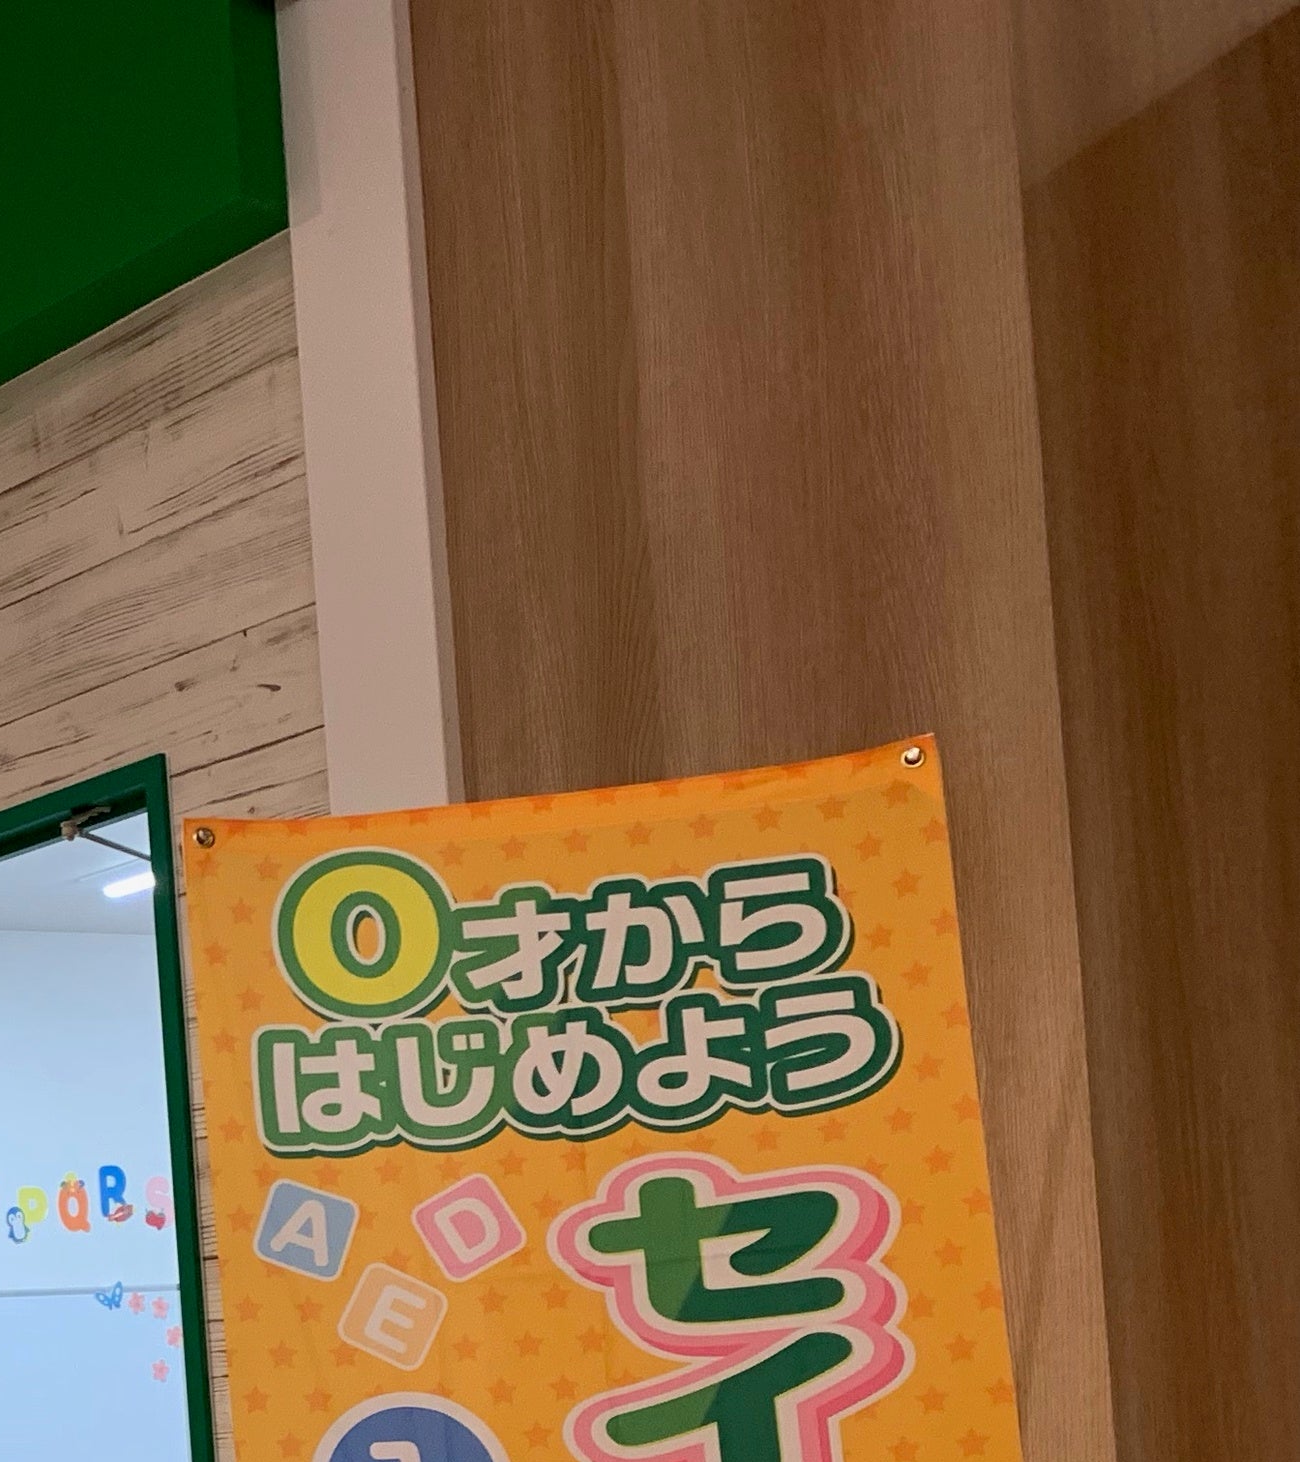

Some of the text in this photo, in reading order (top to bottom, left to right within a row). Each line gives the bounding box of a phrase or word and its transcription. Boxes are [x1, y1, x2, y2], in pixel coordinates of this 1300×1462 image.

[257, 977, 898, 1150] はじめよう
[269, 1197, 335, 1267] A
[430, 1192, 502, 1260] D
[366, 1277, 431, 1358] E
